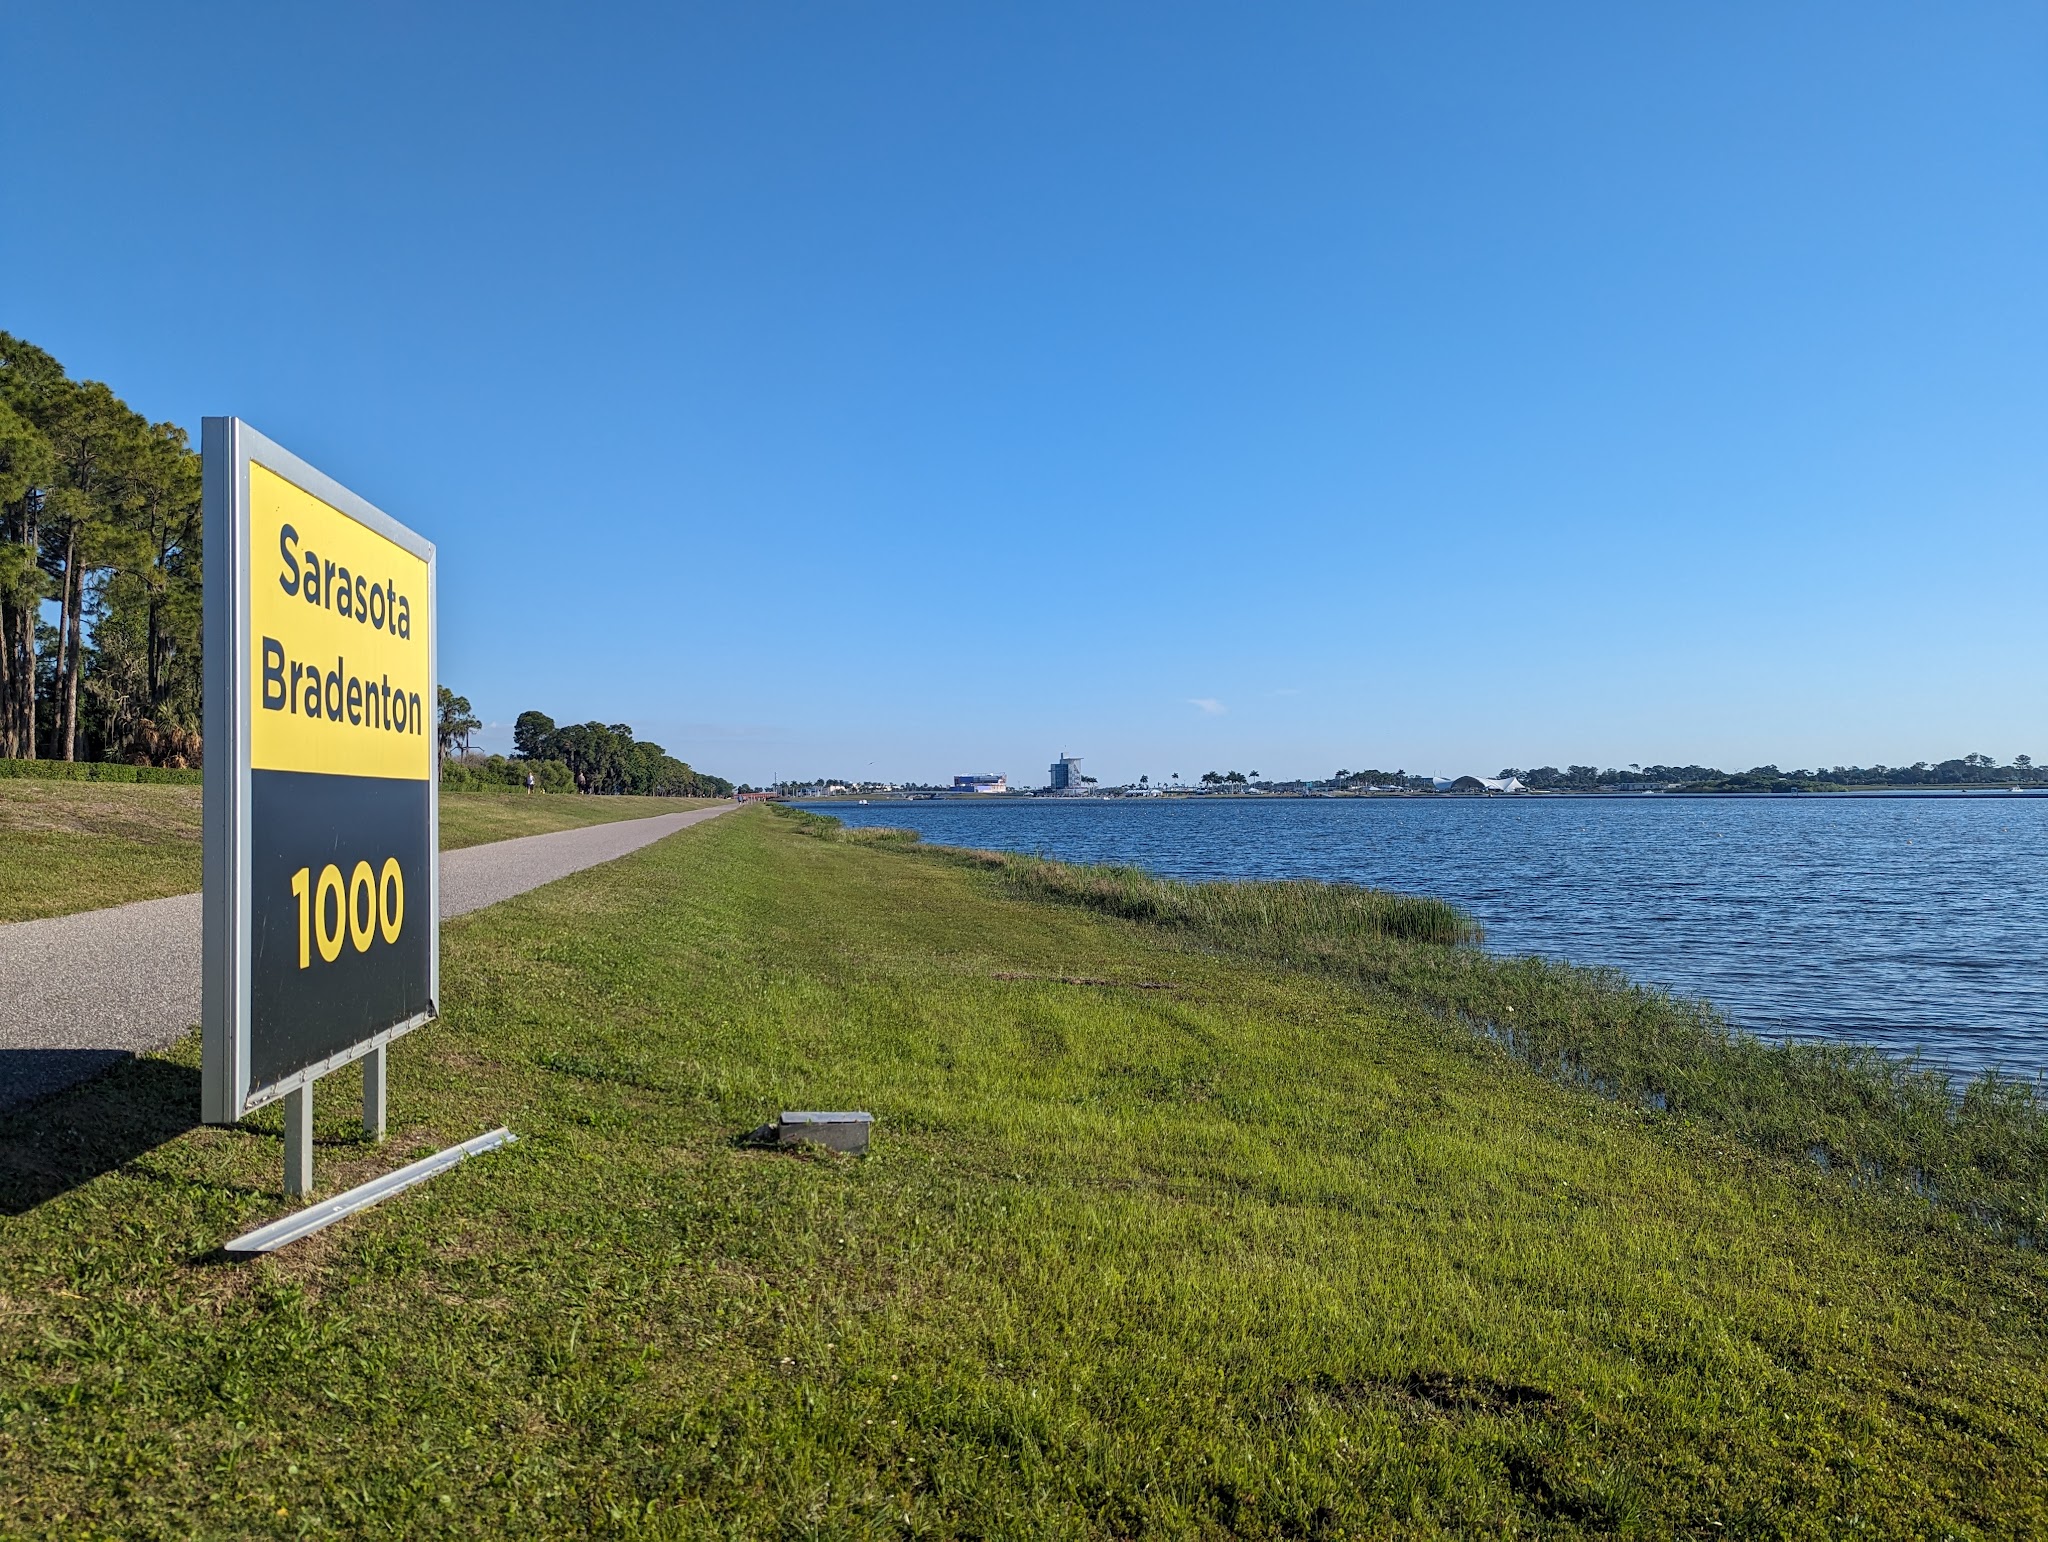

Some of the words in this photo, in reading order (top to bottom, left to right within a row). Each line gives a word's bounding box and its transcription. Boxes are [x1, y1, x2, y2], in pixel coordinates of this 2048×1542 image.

[279, 523, 411, 641] Sarasota
[262, 635, 422, 736] Bradenton
[291, 856, 404, 969] 1000
